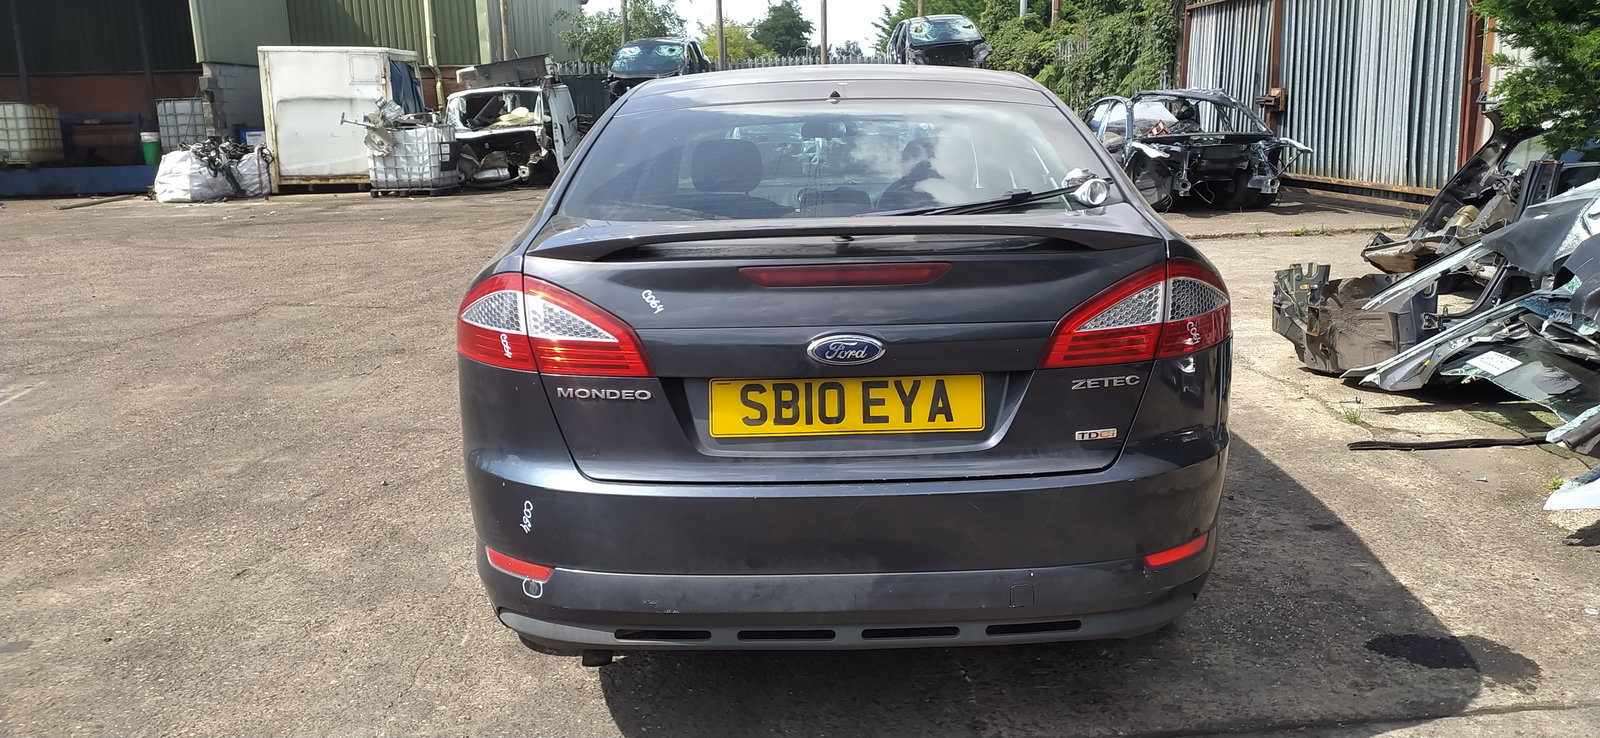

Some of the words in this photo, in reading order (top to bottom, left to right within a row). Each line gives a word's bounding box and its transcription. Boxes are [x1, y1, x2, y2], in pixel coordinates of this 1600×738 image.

[824, 341, 869, 360] Ford
[1071, 375, 1140, 390] ZETEC
[556, 387, 652, 400] MONDEO
[740, 382, 846, 427] SB10
[862, 379, 954, 424] EYA
